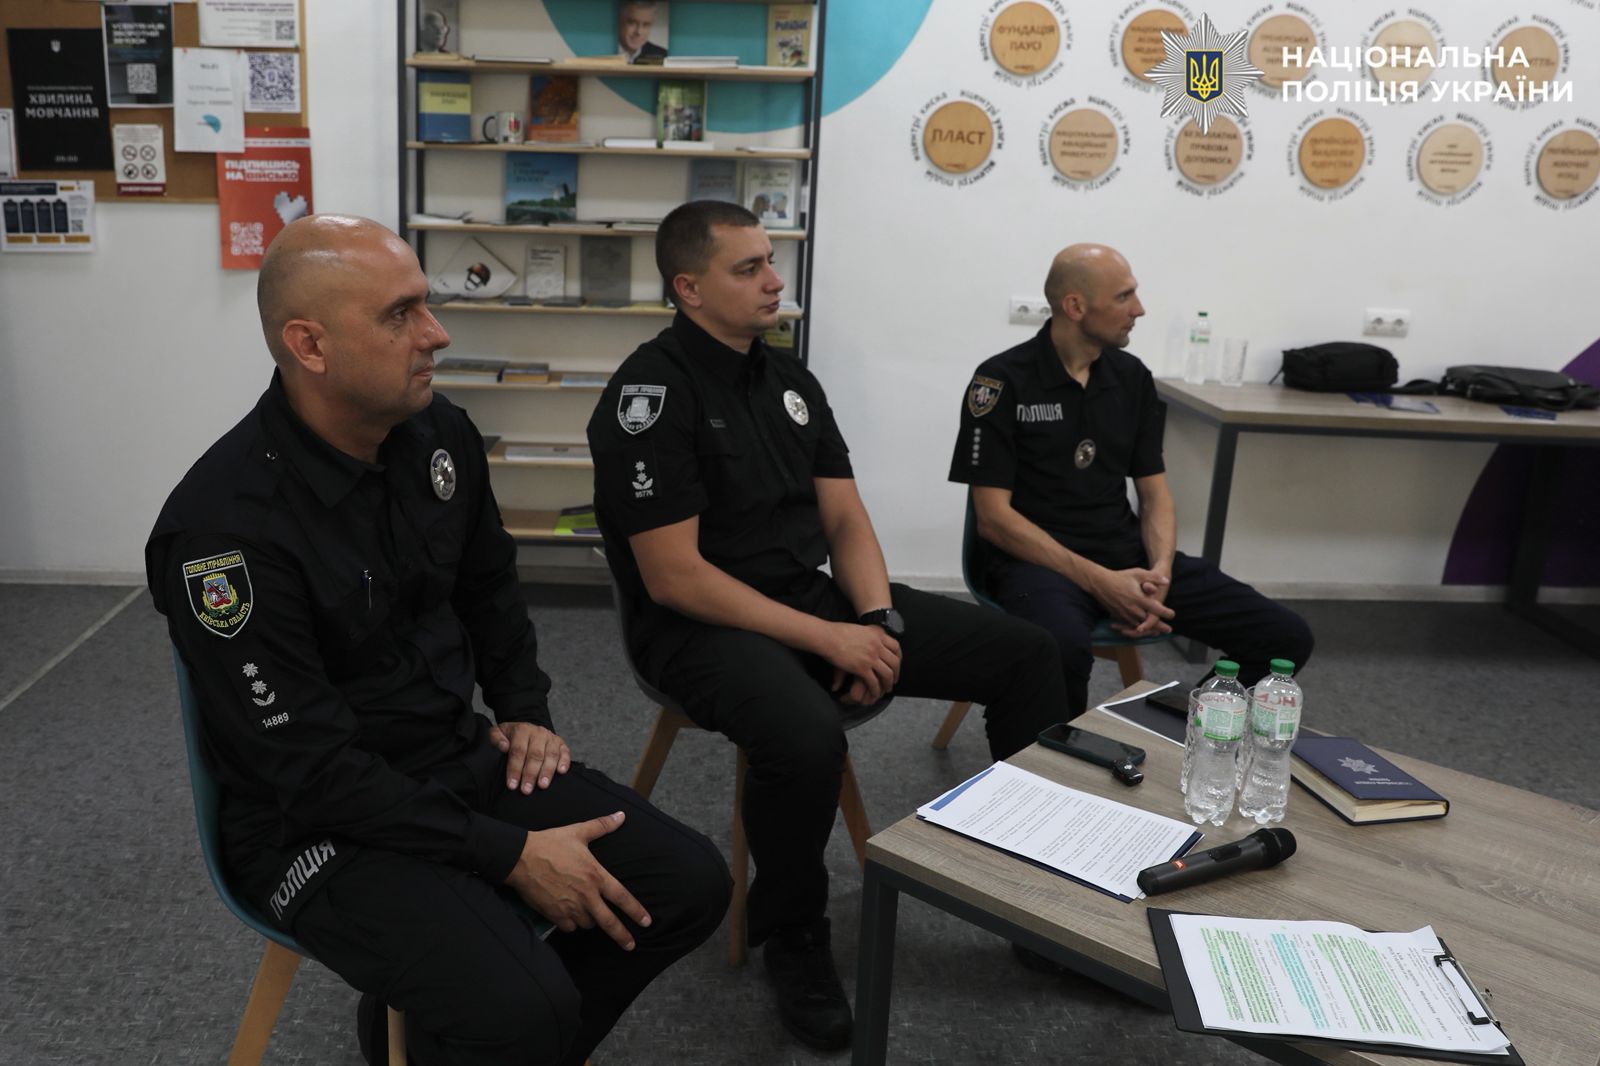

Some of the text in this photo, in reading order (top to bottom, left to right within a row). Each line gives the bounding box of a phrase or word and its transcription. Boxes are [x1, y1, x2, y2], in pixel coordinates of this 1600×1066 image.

[29, 93, 94, 105] ХВИЛИНА
[25, 107, 99, 118] МОВЧАННЯ
[931, 128, 986, 145] ПЛАСТ
[225, 171, 244, 180] НА
[1016, 403, 1063, 423] ПОЛІЦІЯ
[185, 554, 242, 575] ГОЛОВНЕ УПРАВЛІННЯ
[199, 602, 251, 628] КИЇВСЬКА ОБЛАСТЬ
[261, 712, 290, 729] 14889
[269, 840, 337, 920] ПОЛІЦІЯ
